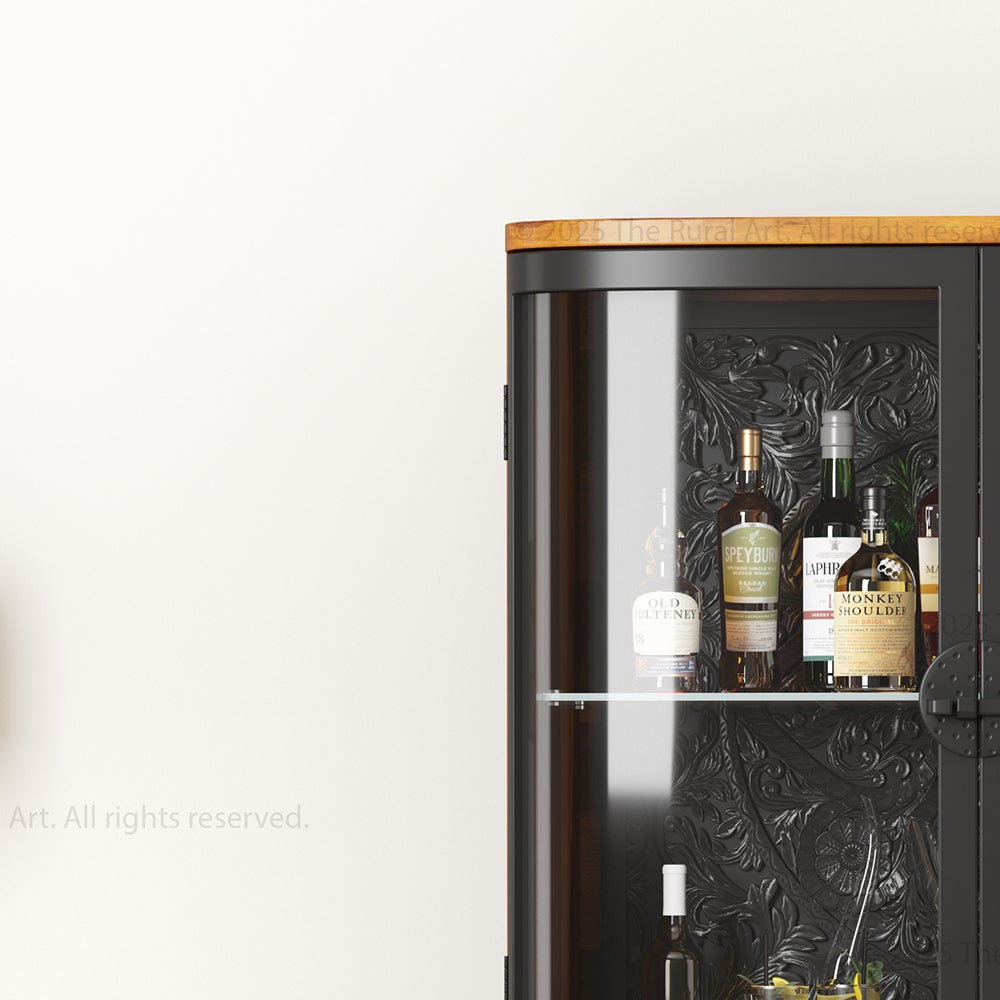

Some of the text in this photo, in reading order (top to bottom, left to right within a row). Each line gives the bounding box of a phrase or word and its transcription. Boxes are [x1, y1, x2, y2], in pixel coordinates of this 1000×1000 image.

[648, 598, 680, 608] OLD
[842, 593, 903, 604] MONKEY
[838, 606, 907, 616] SHOULDER
